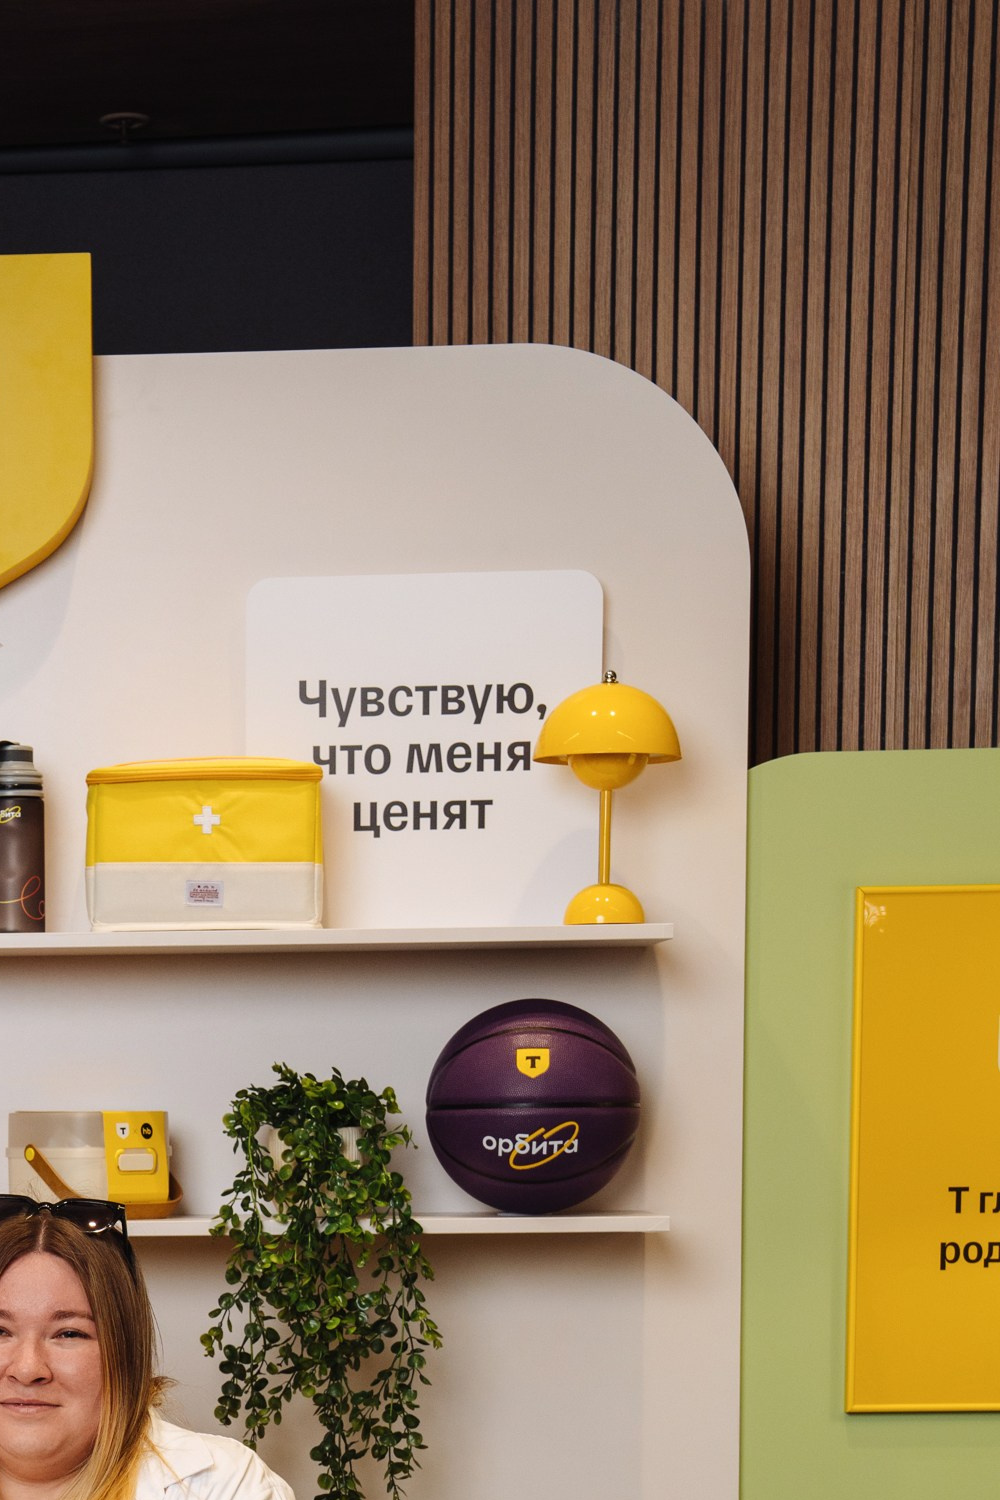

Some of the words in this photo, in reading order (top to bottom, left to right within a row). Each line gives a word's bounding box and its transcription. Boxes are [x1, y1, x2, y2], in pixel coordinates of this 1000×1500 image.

[298, 679, 548, 728] Чувствую,
[312, 743, 392, 776] что
[405, 740, 532, 774] меня
[352, 798, 494, 839] ценят
[525, 1055, 541, 1069] Т
[947, 1186, 970, 1214] Т
